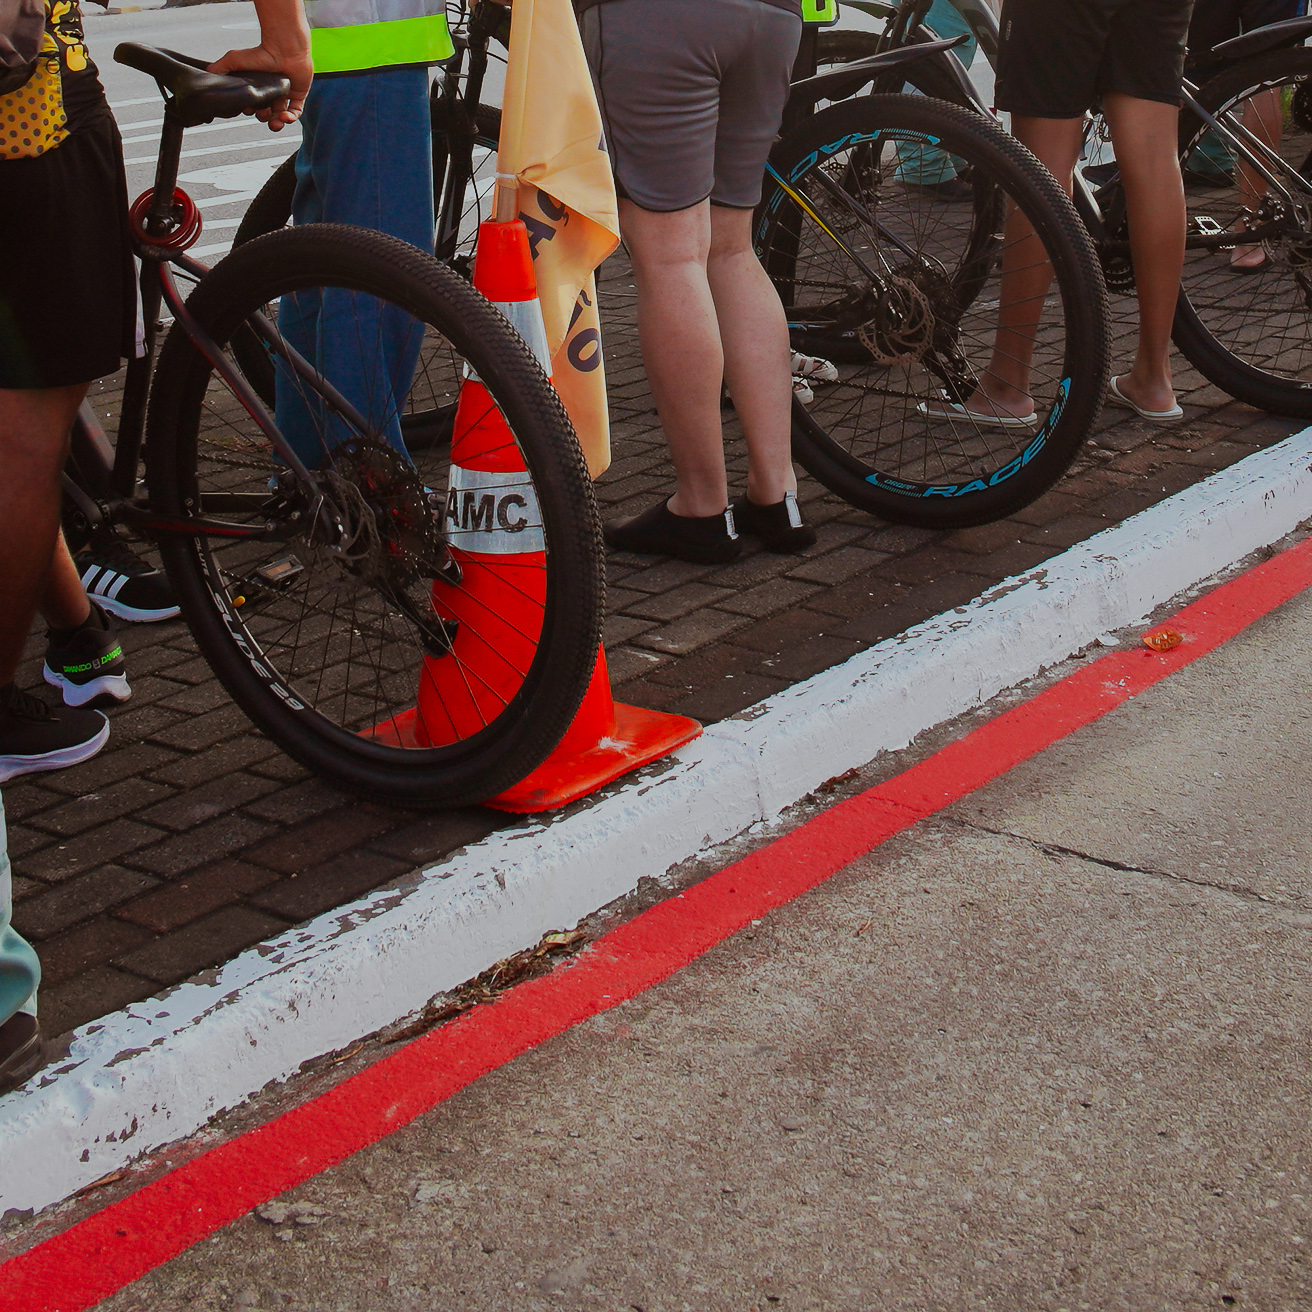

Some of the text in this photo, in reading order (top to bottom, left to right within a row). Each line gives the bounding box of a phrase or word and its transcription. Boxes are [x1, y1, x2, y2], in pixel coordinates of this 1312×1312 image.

[922, 428, 1047, 498] RACE
[445, 486, 528, 534] AMC
[214, 592, 272, 679] SLIDE
